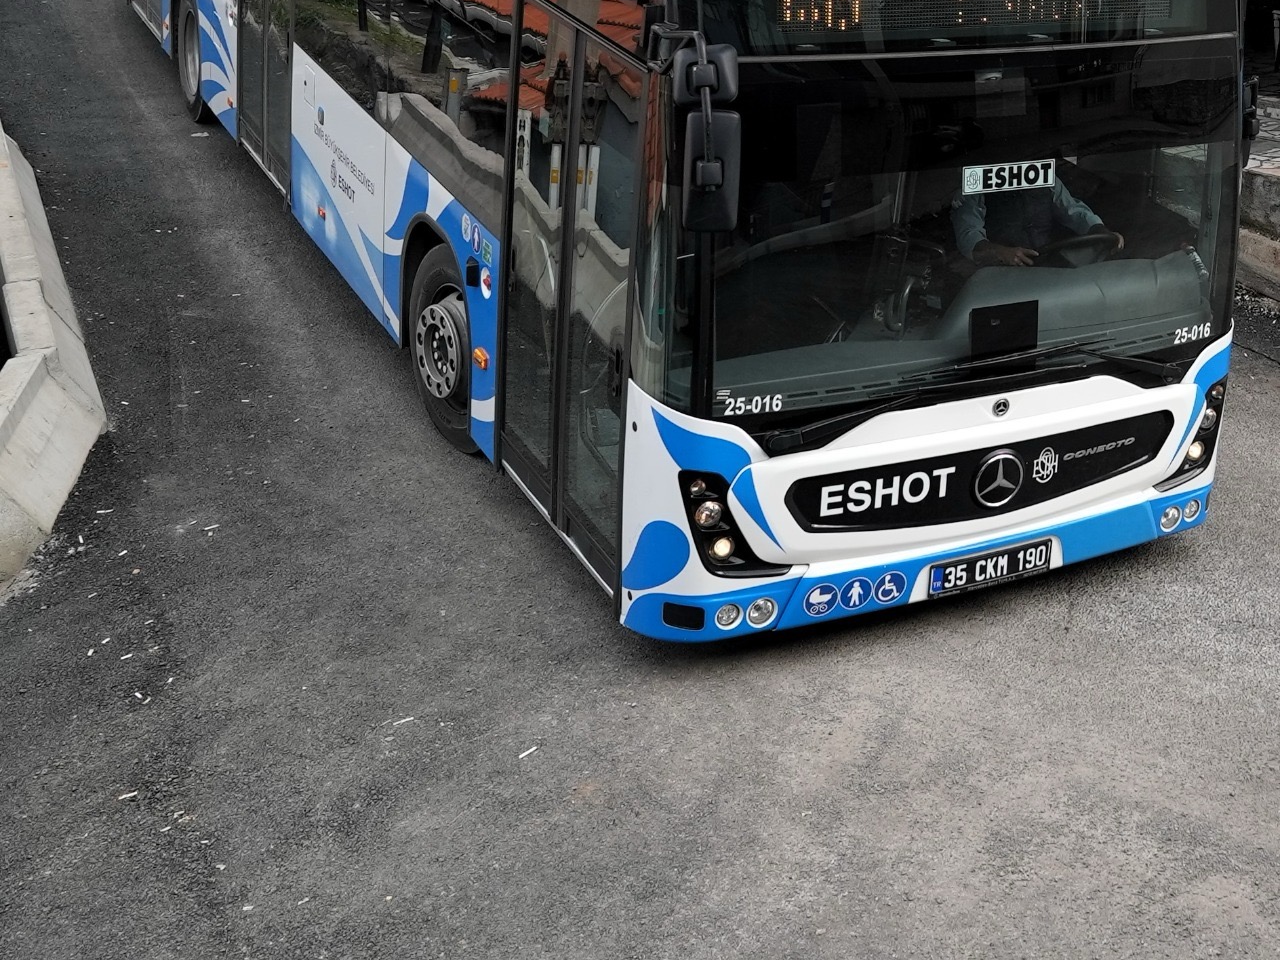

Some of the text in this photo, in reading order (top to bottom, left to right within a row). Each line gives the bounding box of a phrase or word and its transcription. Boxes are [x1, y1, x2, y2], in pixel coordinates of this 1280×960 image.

[338, 174, 356, 203] ESHOT
[982, 162, 1052, 190] ESHOT
[1173, 322, 1211, 345] 25-016
[723, 393, 783, 416] 25-016
[1063, 437, 1136, 460] CONECTO
[819, 466, 956, 517] ESHOT
[943, 545, 1047, 588] 35 CKM 190
